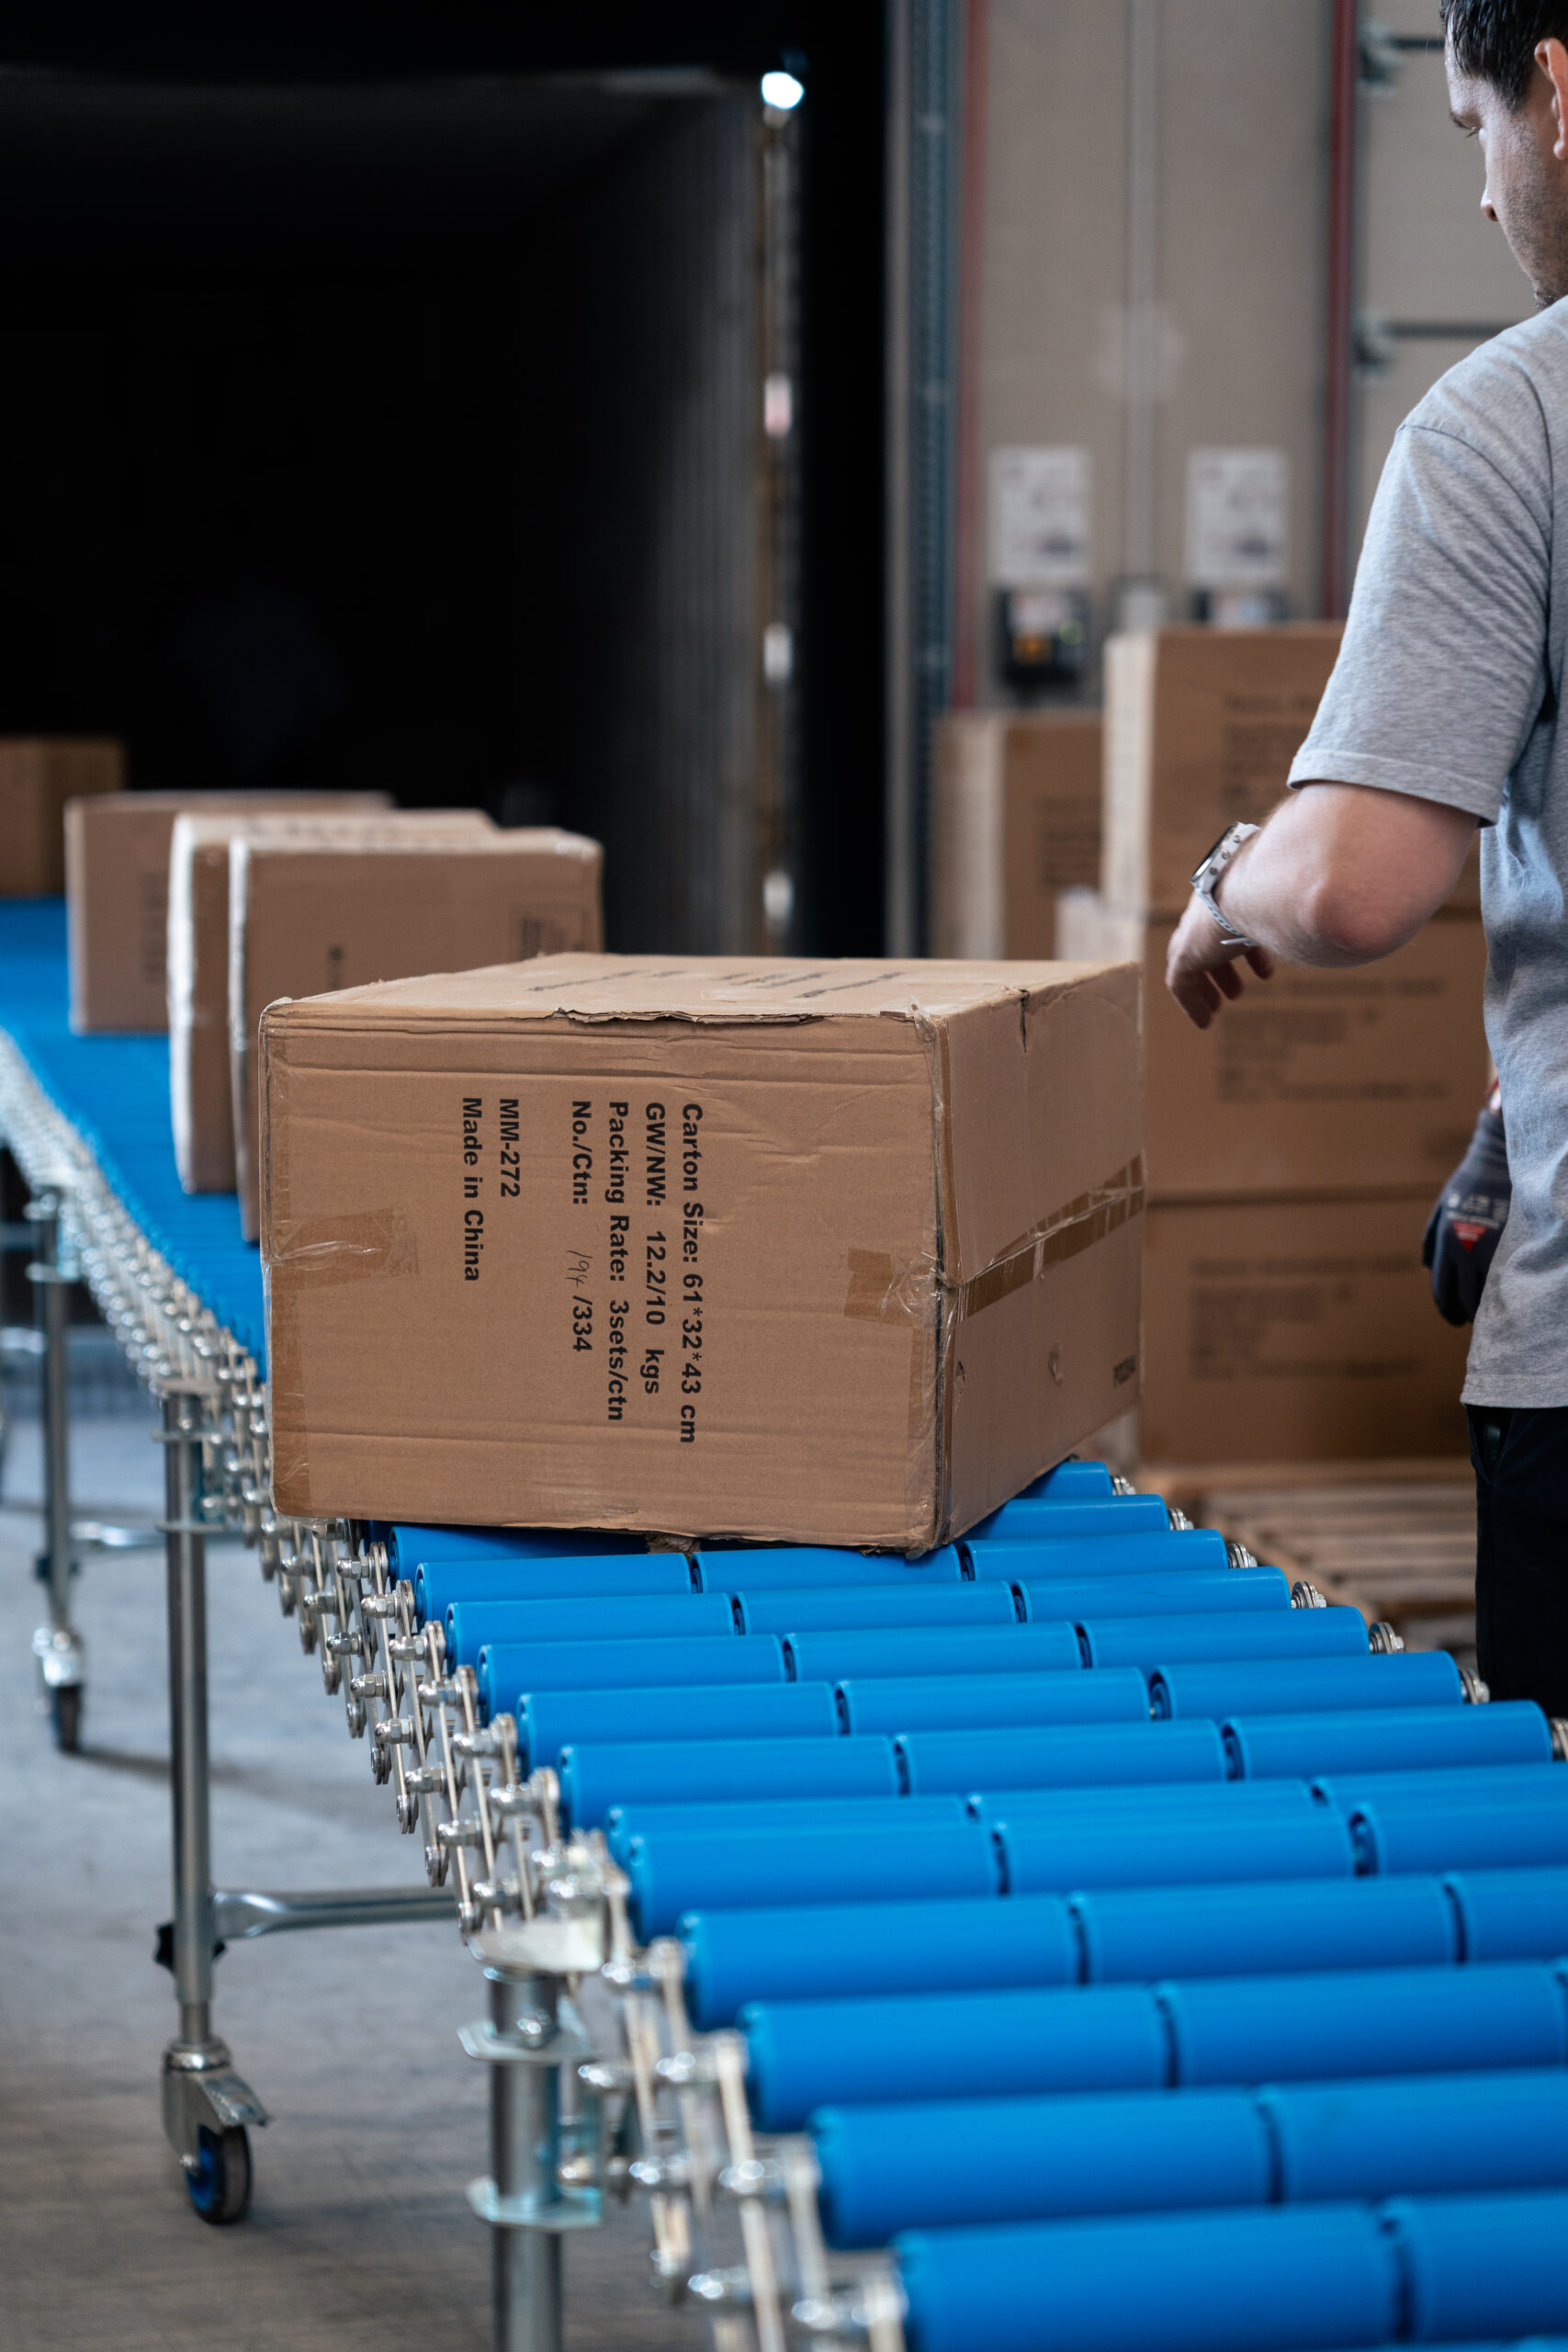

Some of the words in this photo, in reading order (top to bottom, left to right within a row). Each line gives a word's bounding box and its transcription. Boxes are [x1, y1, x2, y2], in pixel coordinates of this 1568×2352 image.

[462, 1097, 483, 1167] Made
[499, 1098, 521, 1198] MM-272
[571, 1101, 593, 1204] No./Ctn:
[604, 1101, 630, 1204] Packing
[645, 1102, 666, 1206] GW/NW:
[682, 1102, 704, 1192] Carton
[463, 1176, 484, 1199] in
[463, 1209, 484, 1282] China
[609, 1215, 630, 1282] Rate:
[682, 1202, 705, 1263] Size:
[645, 1230, 667, 1326] 12.2/10
[572, 1295, 593, 1352] /334
[607, 1299, 630, 1421] 3sets/ctn
[639, 1348, 665, 1395] kgs
[680, 1404, 696, 1443] cm
